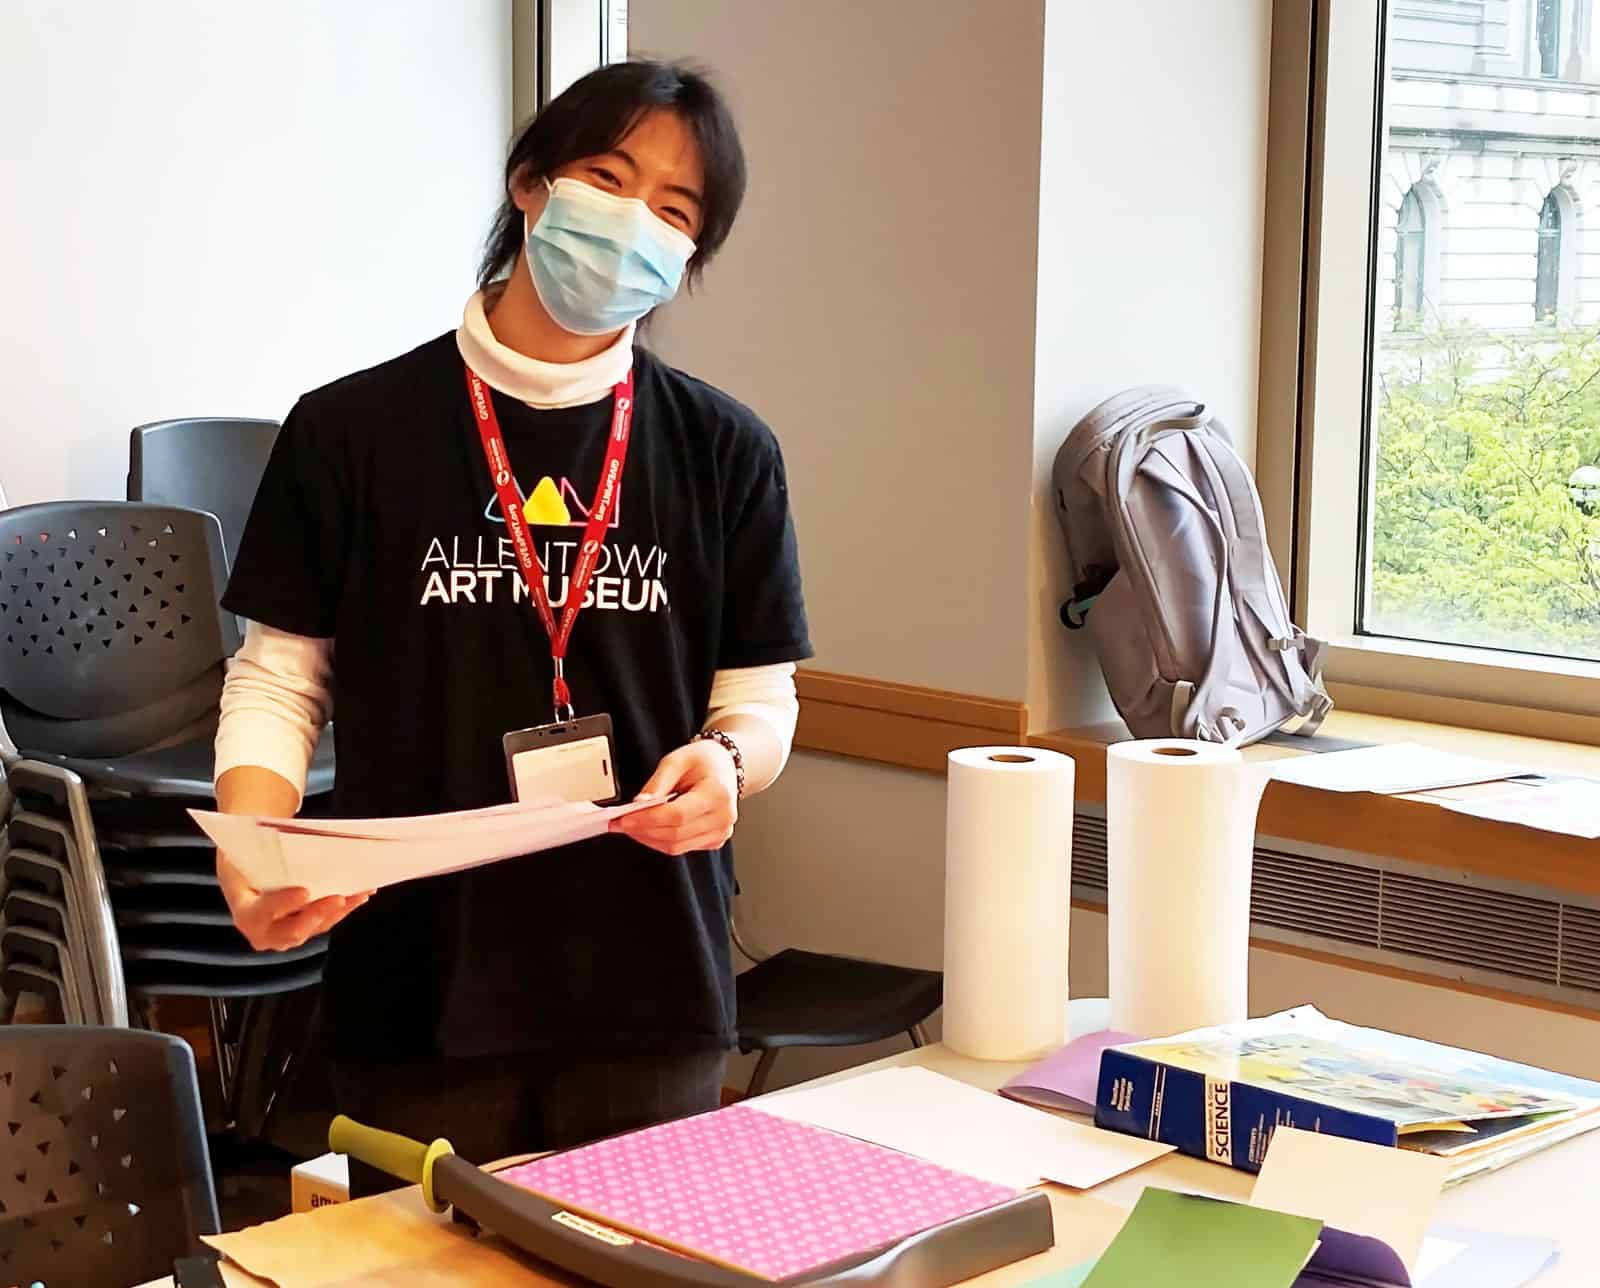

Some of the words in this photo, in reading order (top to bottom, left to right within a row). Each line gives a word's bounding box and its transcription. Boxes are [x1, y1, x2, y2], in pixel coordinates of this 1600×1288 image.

[420, 570, 503, 605] ART
[1215, 1083, 1230, 1157] SCIENCE
[312, 1193, 340, 1208] am
